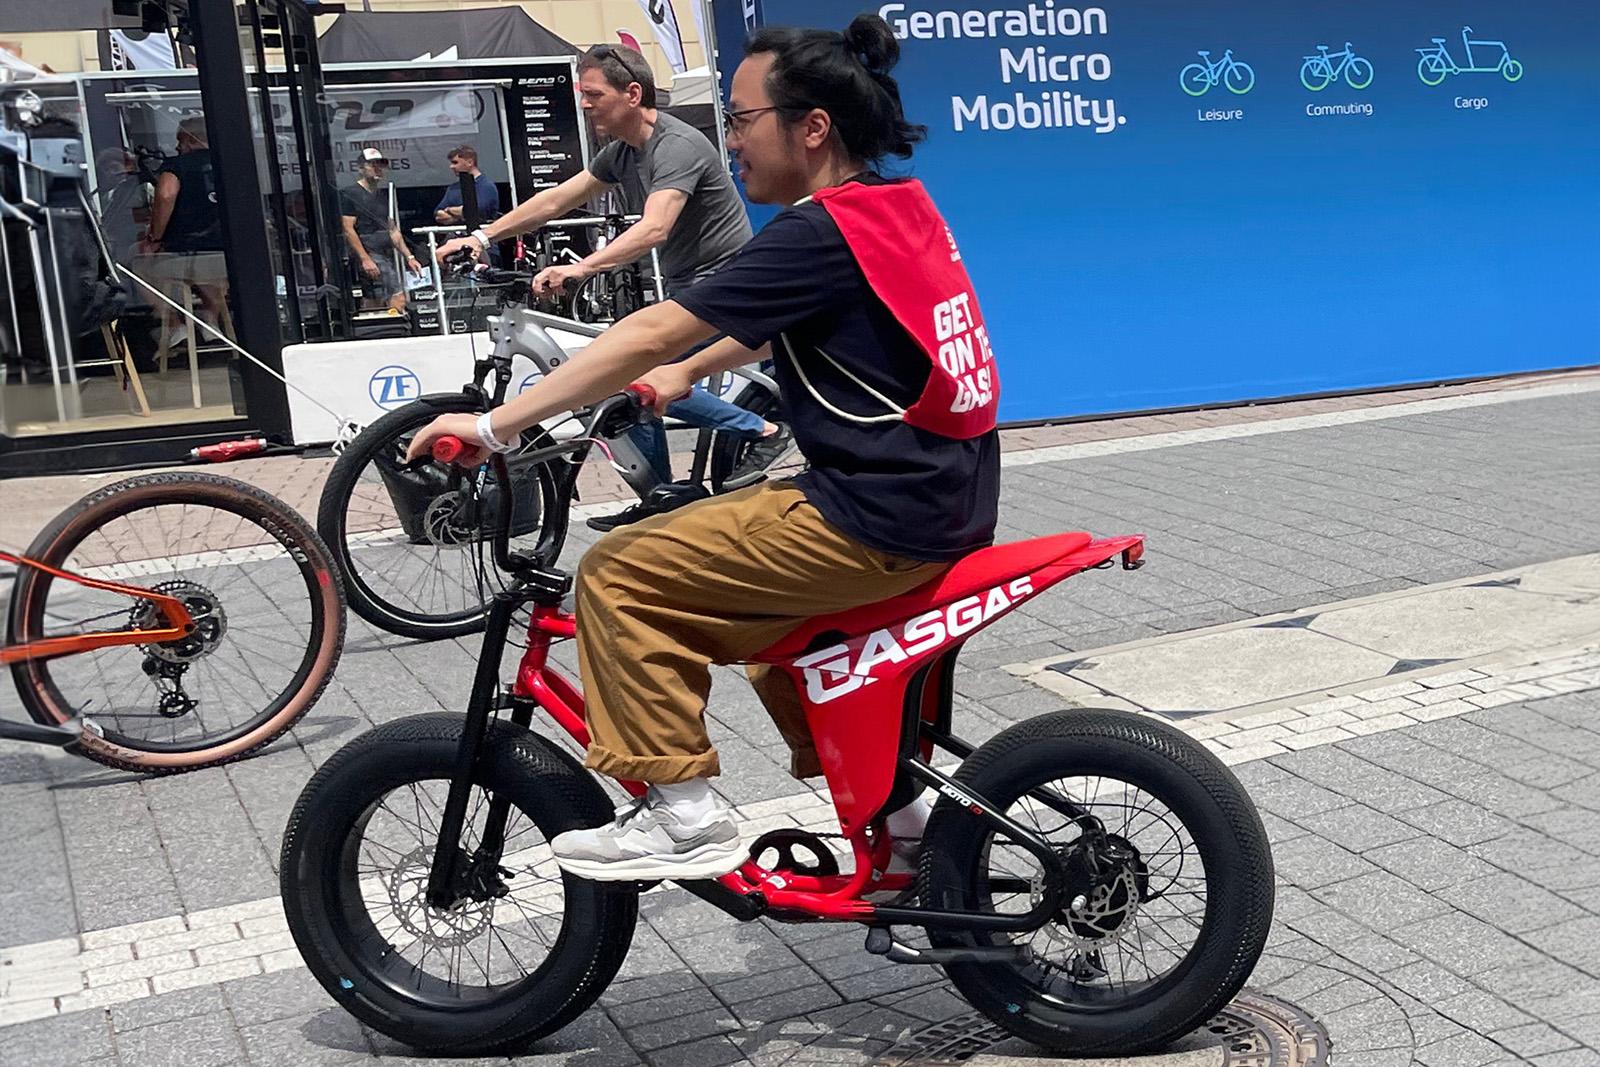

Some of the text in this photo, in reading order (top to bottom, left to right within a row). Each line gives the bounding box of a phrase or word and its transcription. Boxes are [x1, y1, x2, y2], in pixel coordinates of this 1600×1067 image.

[878, 0, 1108, 40] Generation
[1000, 46, 1111, 84] Micro
[951, 91, 1127, 134] Mobility.
[1197, 109, 1243, 121] Leisure
[1306, 103, 1373, 118] Commuting
[1454, 96, 1489, 111] Cargo
[933, 292, 974, 342] GET
[938, 333, 976, 378] ON
[372, 374, 416, 405] ZF
[791, 575, 1034, 705] GASGAS
[939, 784, 973, 807] MOTO
